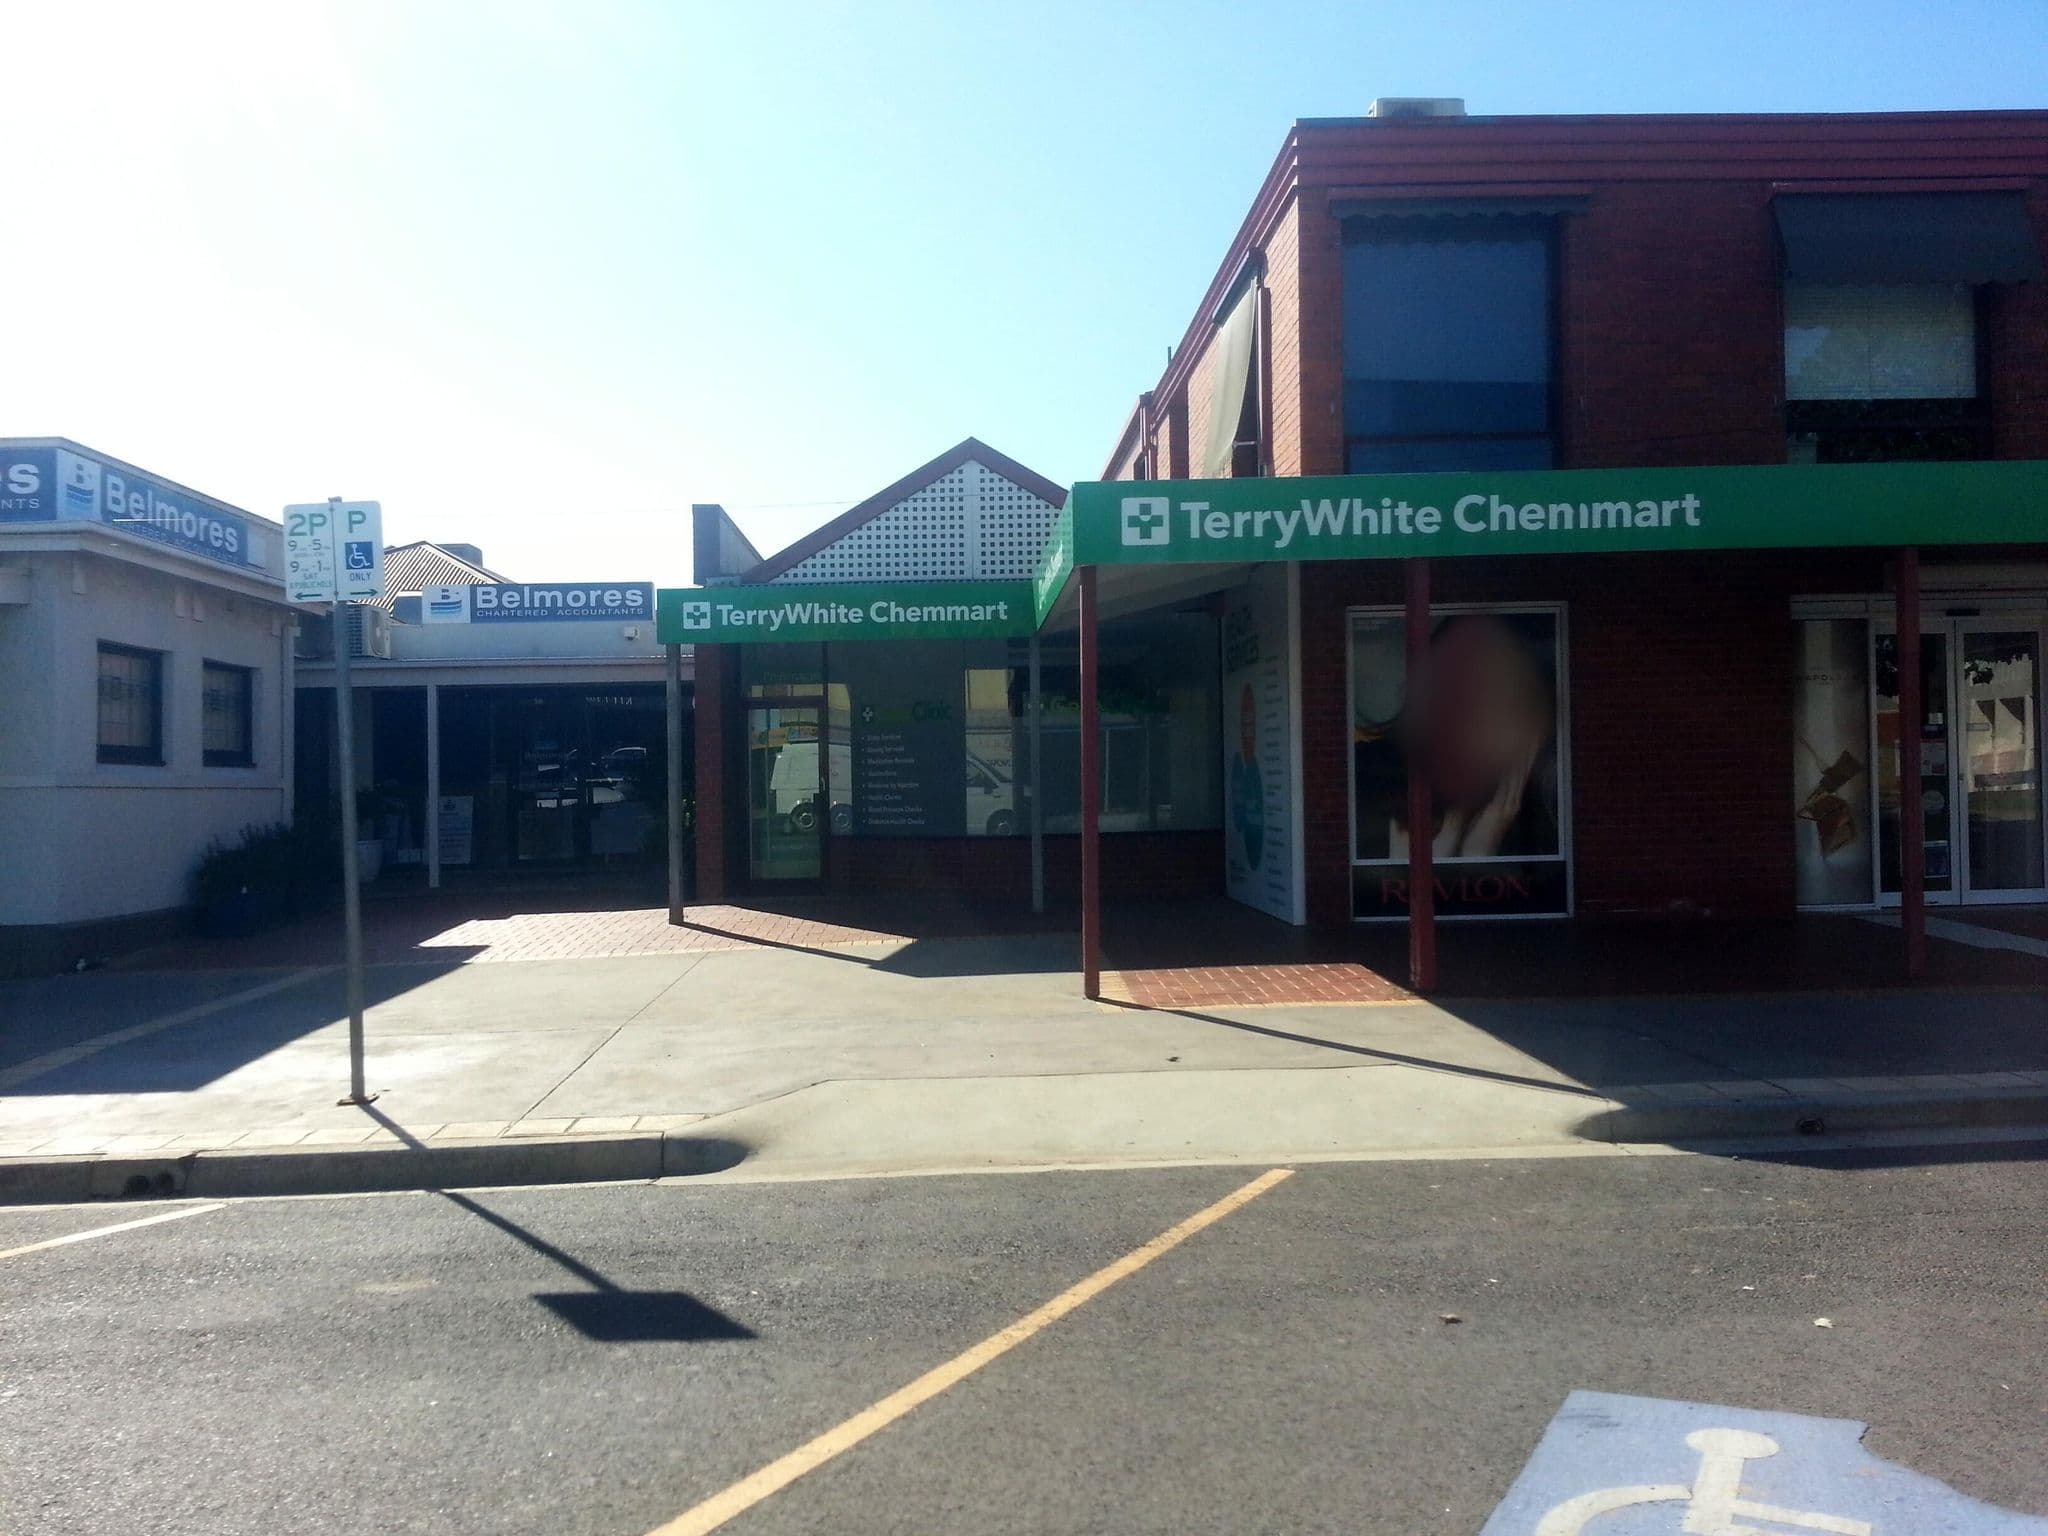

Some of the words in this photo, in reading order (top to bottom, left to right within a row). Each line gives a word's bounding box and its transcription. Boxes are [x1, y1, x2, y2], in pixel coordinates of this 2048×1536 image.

[105, 473, 239, 552] Belmores
[347, 510, 367, 534] P
[1180, 497, 1443, 549] TerryWhite
[288, 513, 328, 537] 2P
[349, 572, 372, 582] ONLY
[476, 585, 644, 609] Belmores
[476, 609, 549, 617] CHARTERED
[556, 607, 644, 616] ACCOUNTANTS
[716, 602, 864, 632] TerryWhite
[869, 600, 1008, 623] Chemmart
